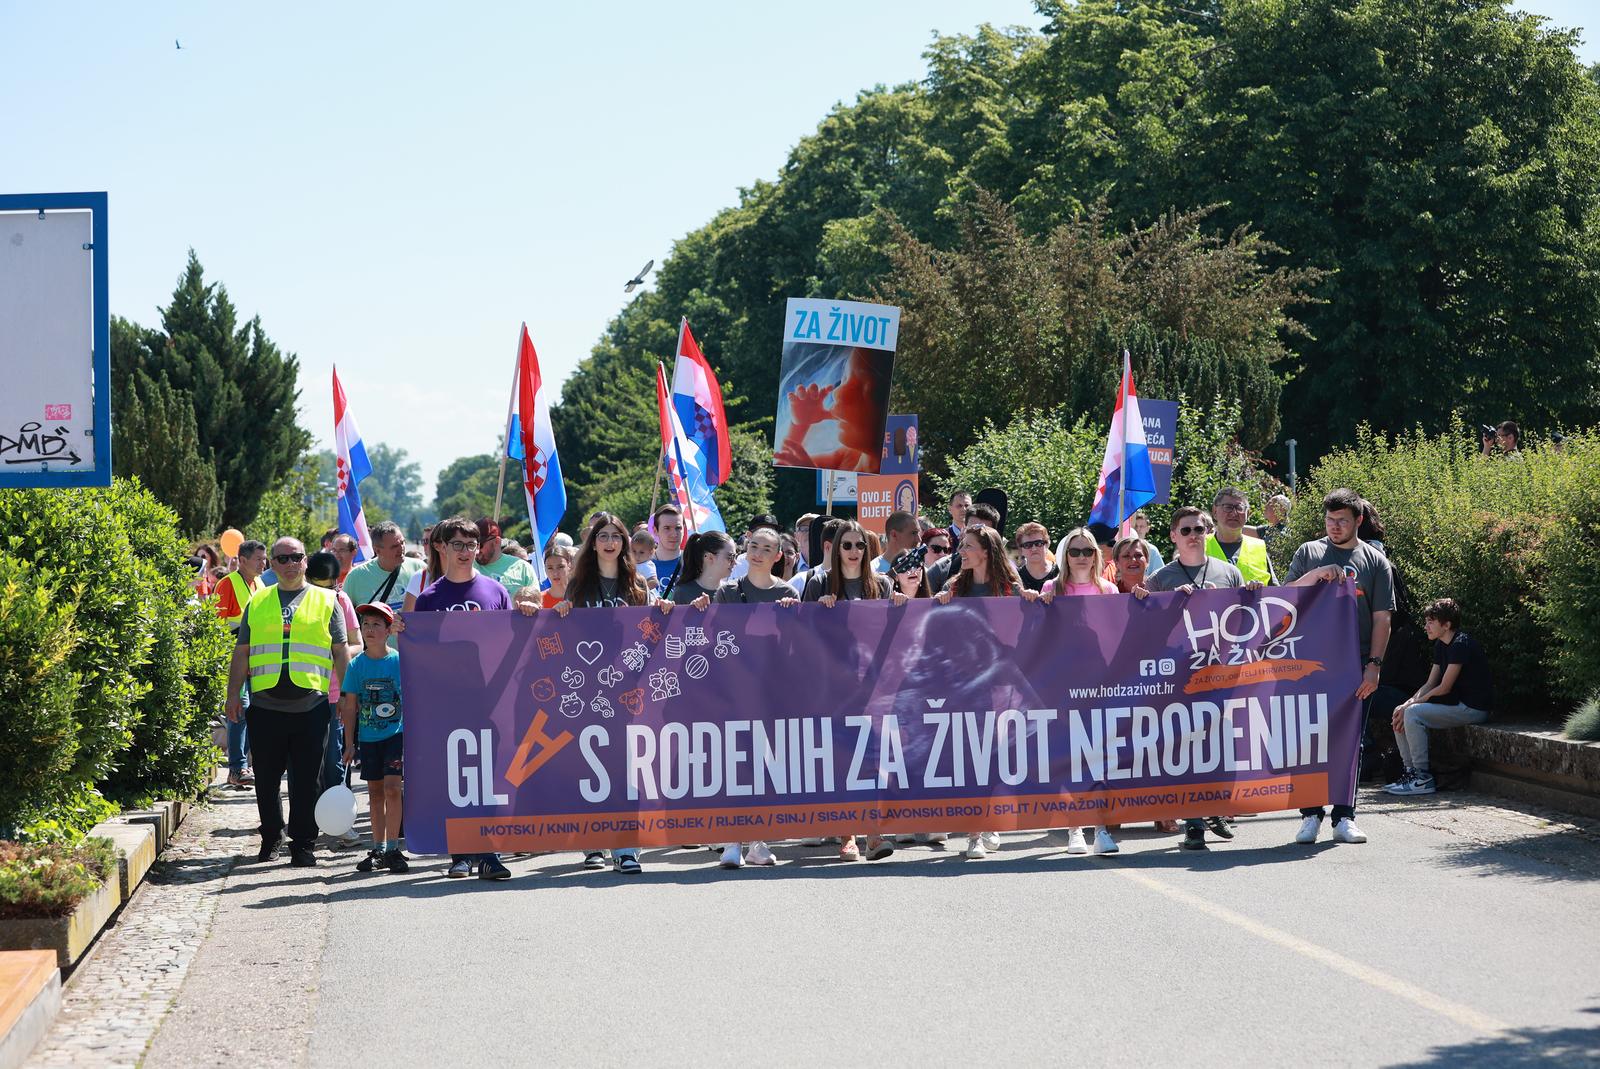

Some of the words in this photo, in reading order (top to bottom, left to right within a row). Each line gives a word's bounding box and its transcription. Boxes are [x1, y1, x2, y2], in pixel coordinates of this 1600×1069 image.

[793, 310, 821, 339] ZA
[827, 306, 891, 346] ŽIVOT
[861, 491, 880, 503] OVO
[881, 490, 892, 503] JE
[861, 505, 892, 518] DIJETE
[1183, 597, 1298, 655] HOD
[1189, 644, 1222, 670] ZA
[1227, 635, 1304, 666] ŽIVOT
[1069, 682, 1175, 699] www.hodzazivot.hr
[626, 716, 835, 801] ROĐENIH
[845, 714, 909, 792] ZA
[923, 699, 1057, 790] ŽIVOT
[1069, 693, 1329, 783] NEROĐENIH
[480, 824, 536, 837] IMOTSKI
[547, 821, 580, 834] KNIN
[591, 819, 646, 833] OPUZEN
[656, 817, 704, 830] OSIJEK
[716, 814, 765, 828] RIJEKA
[776, 812, 806, 825] SINJ
[818, 810, 857, 822] SISAK
[869, 806, 943, 820] SLAVONSKI
[946, 806, 982, 817] BROD
[993, 803, 1030, 815] SPLIT
[1040, 797, 1109, 812] VARAŽDIN
[1117, 793, 1178, 807] VINKOVCI
[1188, 790, 1232, 803] ZADAR
[1242, 783, 1295, 798] ZAGREB
